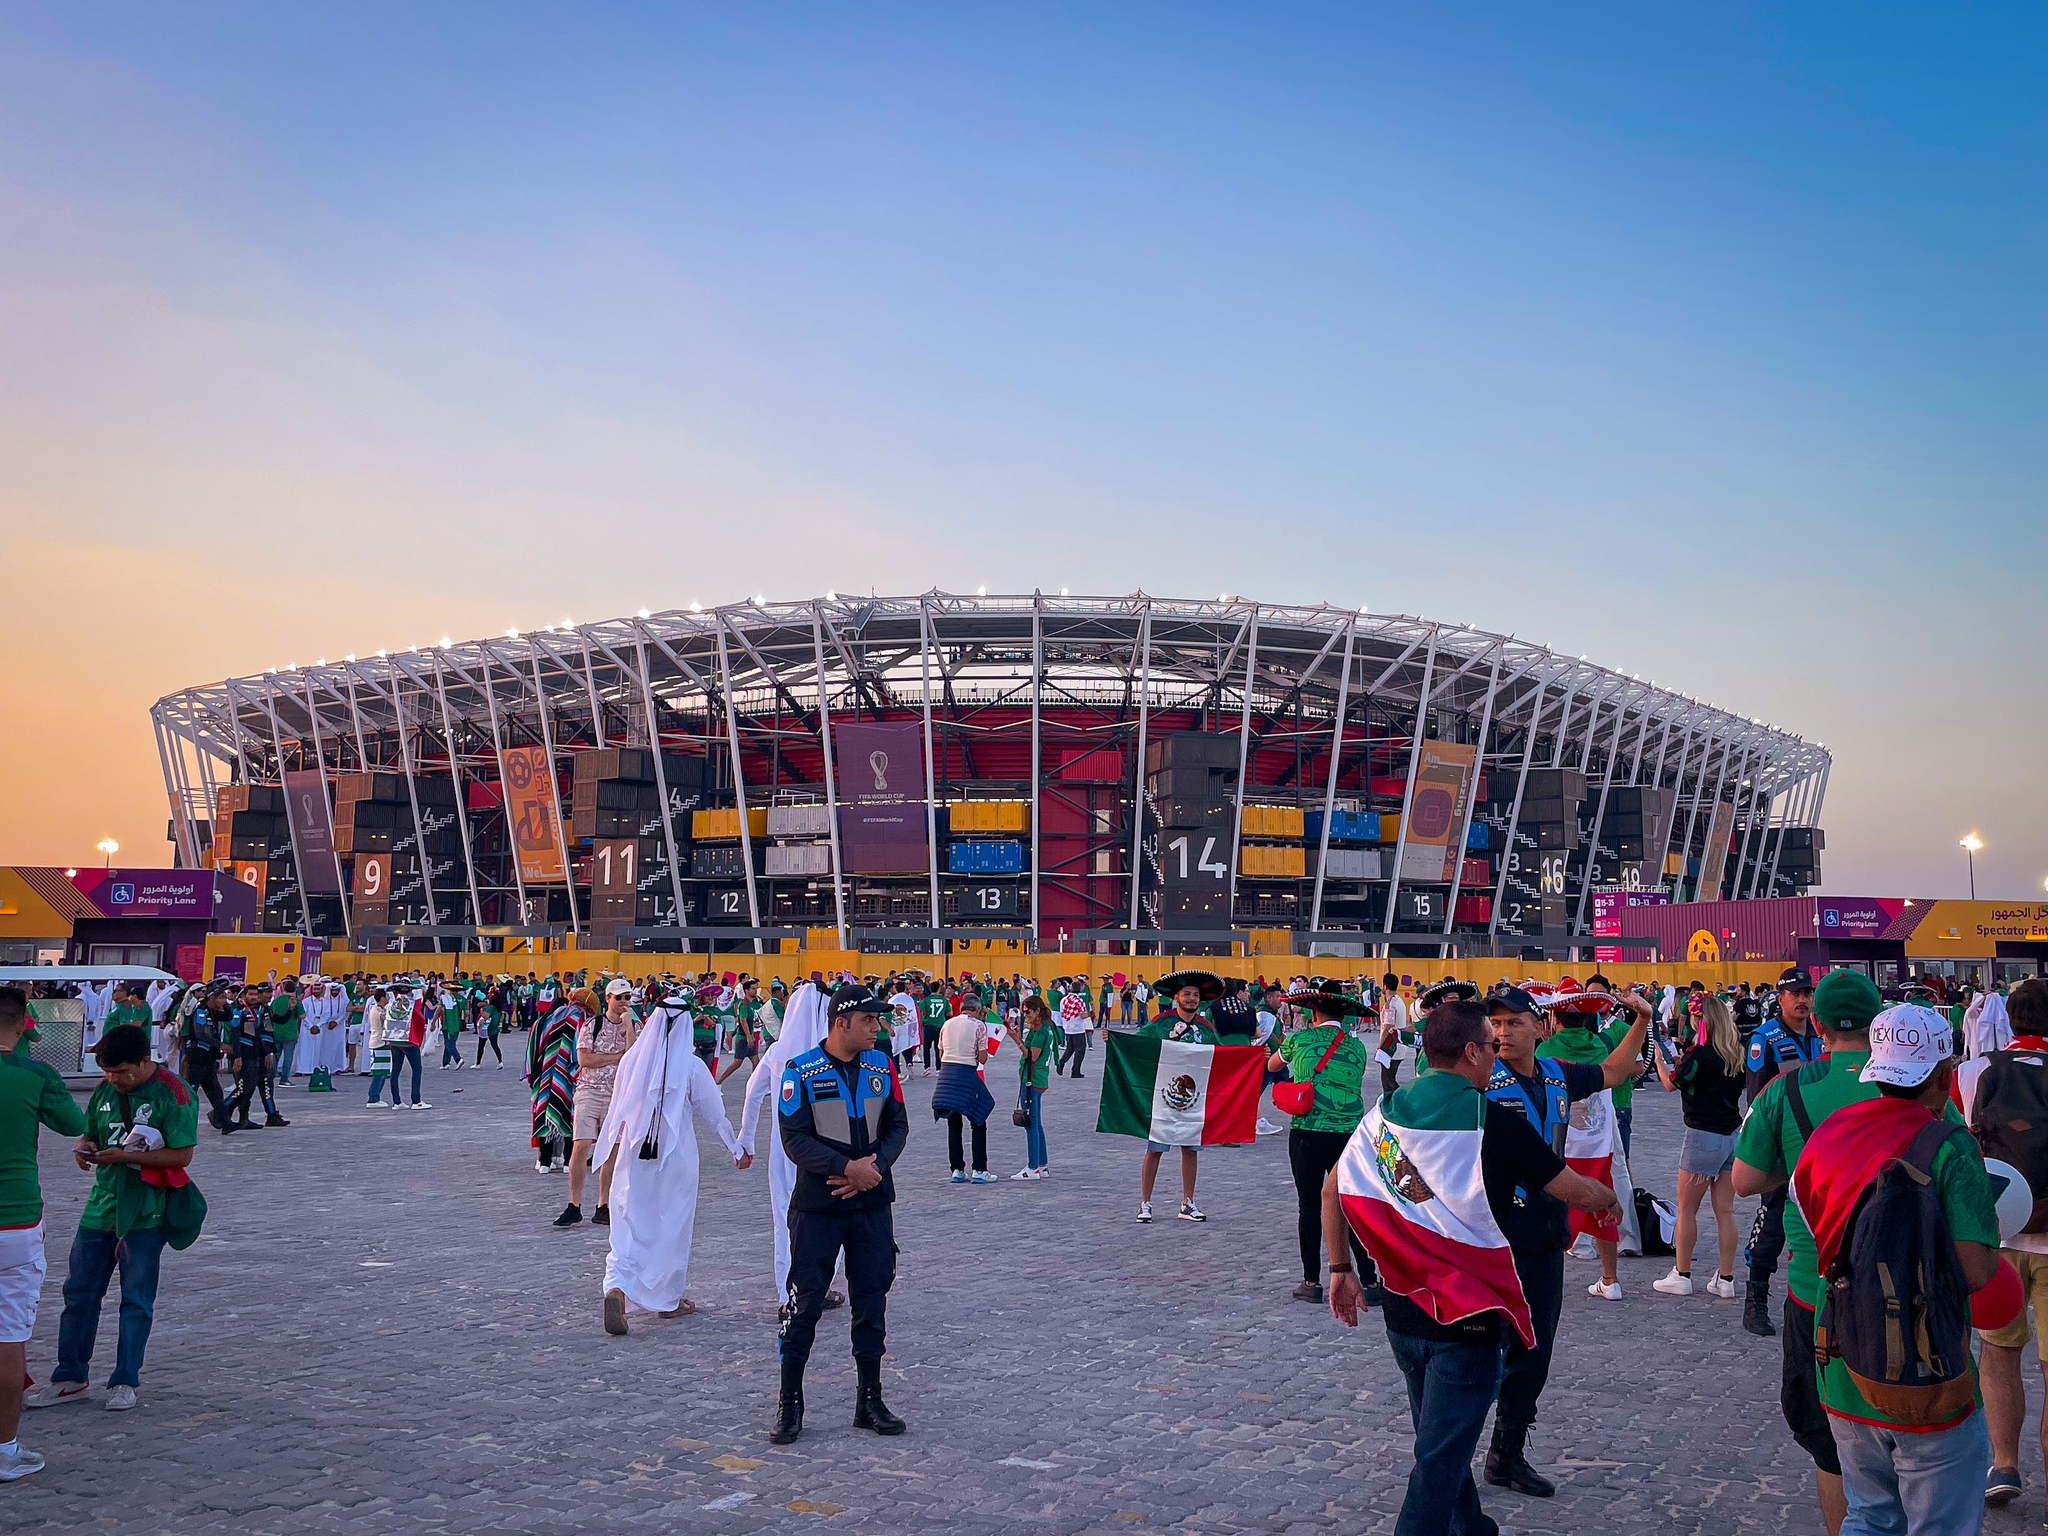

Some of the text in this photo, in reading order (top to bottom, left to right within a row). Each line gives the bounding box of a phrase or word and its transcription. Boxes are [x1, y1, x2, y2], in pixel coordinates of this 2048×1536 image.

[1424, 751, 1440, 763] Am
[1454, 779, 1468, 817] azing
[547, 800, 560, 841] come
[598, 844, 634, 885] 11
[1168, 836, 1228, 879] 14
[364, 859, 381, 896] 9
[1542, 856, 1564, 894] 16
[142, 884, 194, 895] أولوية المرور
[976, 888, 1001, 909] 13
[138, 896, 197, 906] Priority Lane
[654, 895, 678, 918] L2
[721, 892, 739, 913] 12
[1413, 895, 1430, 916] 15
[407, 905, 430, 924] L2
[1841, 920, 1864, 929] Priority
[1991, 907, 2031, 921] الجمهور
[1976, 924, 2029, 938] Spectator
[929, 1002, 944, 1018] 17
[801, 1056, 826, 1070] POLICE
